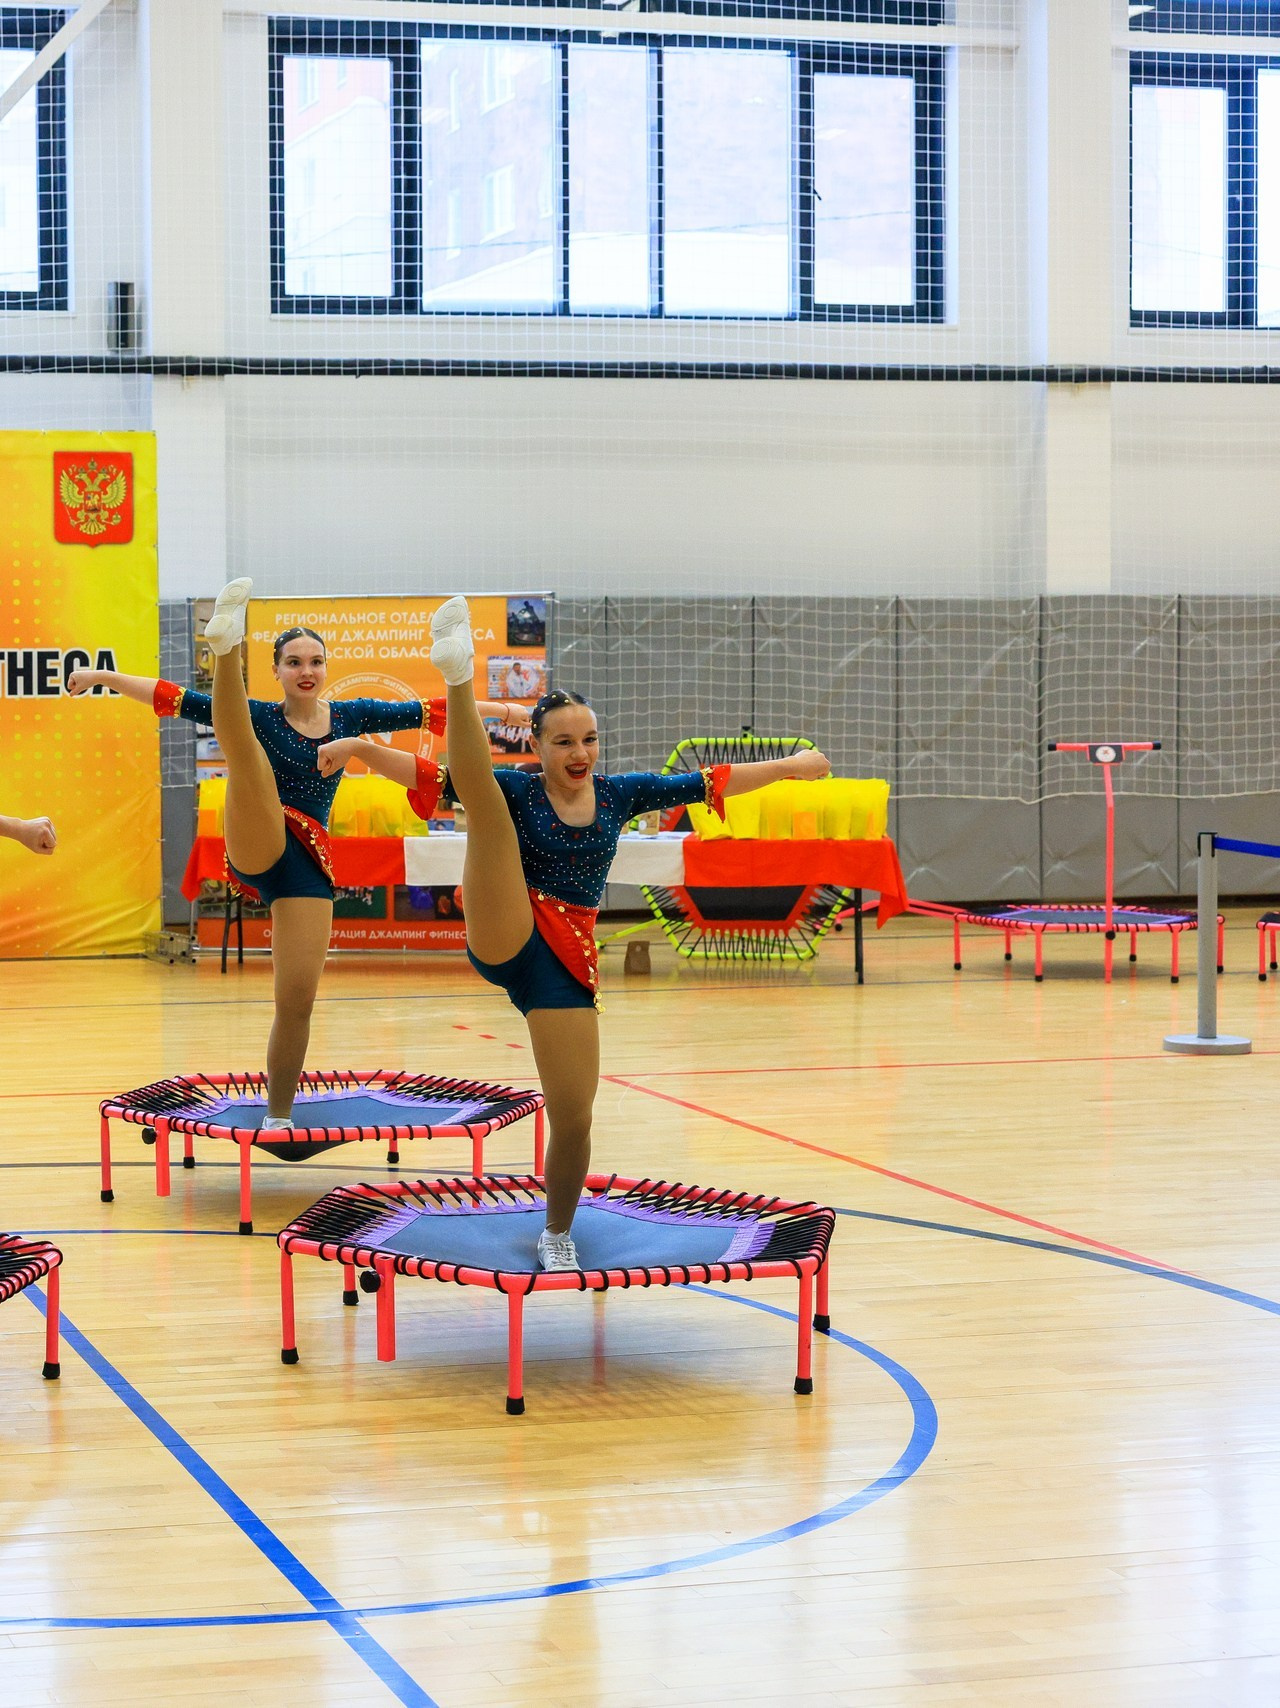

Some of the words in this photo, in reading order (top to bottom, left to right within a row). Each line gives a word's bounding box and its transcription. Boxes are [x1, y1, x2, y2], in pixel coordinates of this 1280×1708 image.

[275, 612, 385, 625] РЕГИОНАЛЬНОЕ
[340, 628, 425, 642] ДЖАМПИНГ
[378, 646, 431, 659] ОБЛАС
[368, 929, 426, 940] ДЖАМПИНГ
[429, 929, 467, 940] ФИТНЕС
